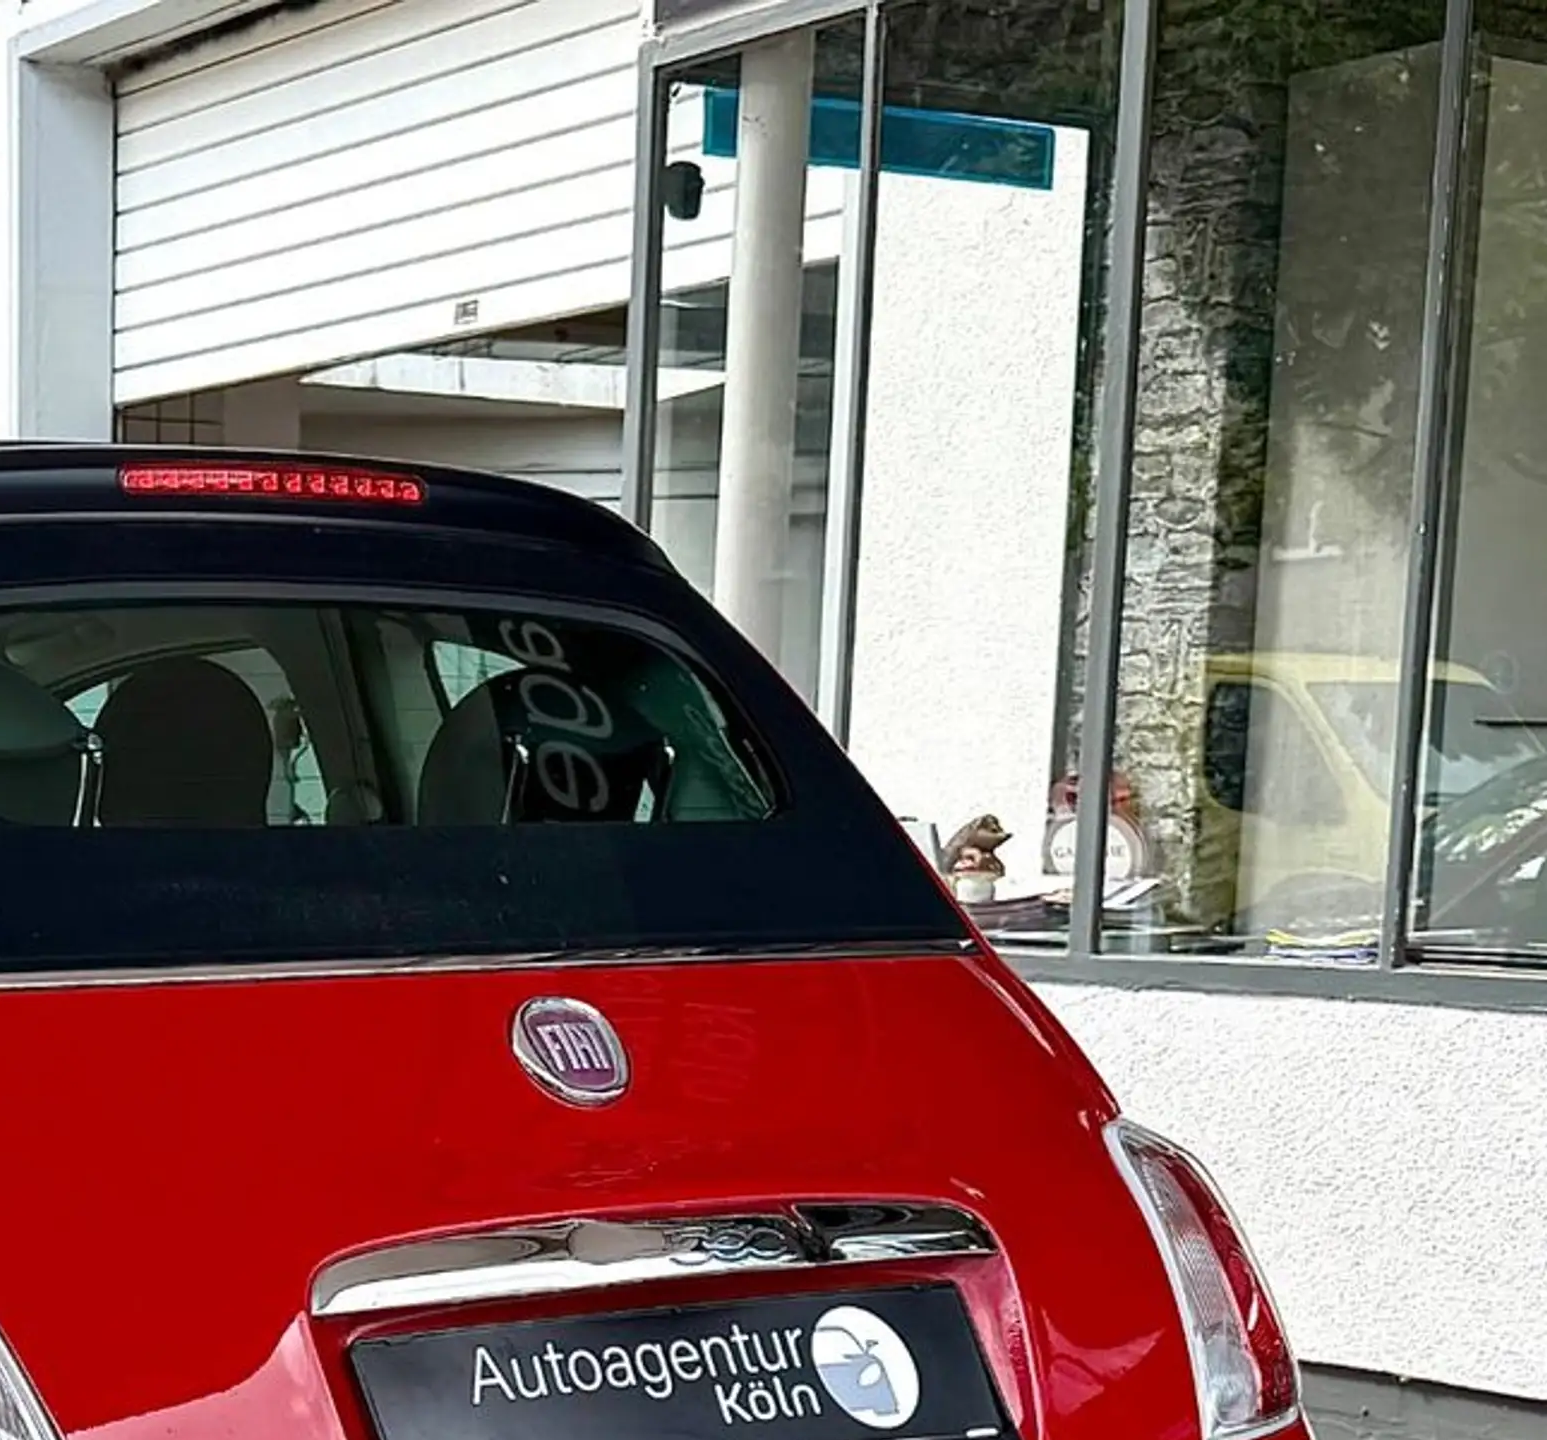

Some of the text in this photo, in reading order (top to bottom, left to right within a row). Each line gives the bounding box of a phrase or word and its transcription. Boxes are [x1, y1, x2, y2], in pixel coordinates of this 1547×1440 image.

[536, 1021, 612, 1072] FIAT
[471, 1323, 803, 1406] Autoagentur
[714, 1374, 822, 1425] Köln
